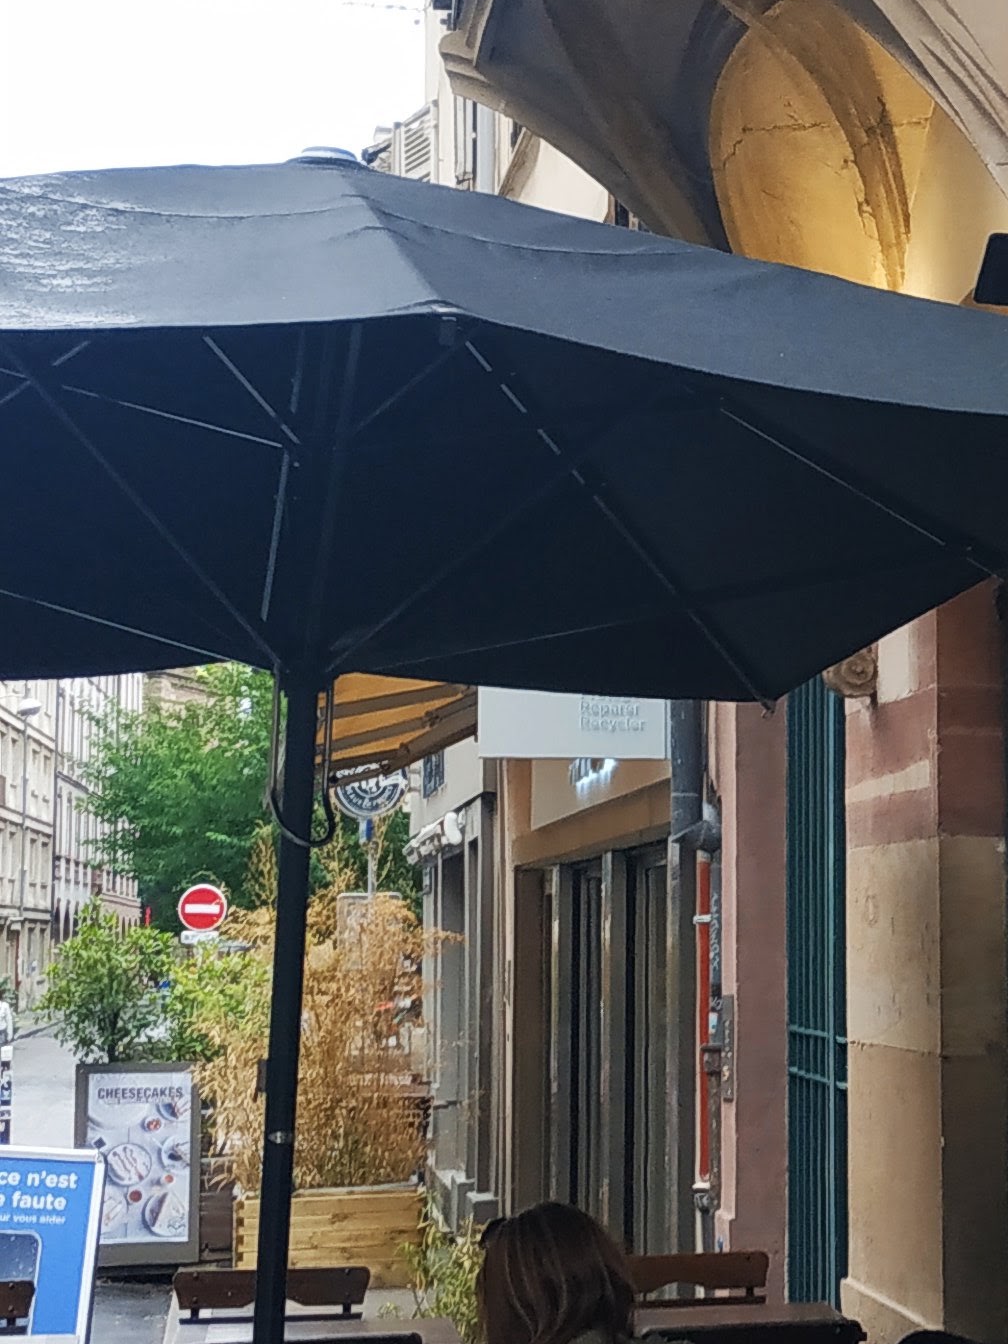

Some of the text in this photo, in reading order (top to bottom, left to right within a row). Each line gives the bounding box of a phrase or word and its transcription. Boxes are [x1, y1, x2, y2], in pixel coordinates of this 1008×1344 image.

[97, 1086, 184, 1099] CHEESECAKES
[27, 1170, 78, 1189] n'est
[12, 1191, 67, 1211] faute
